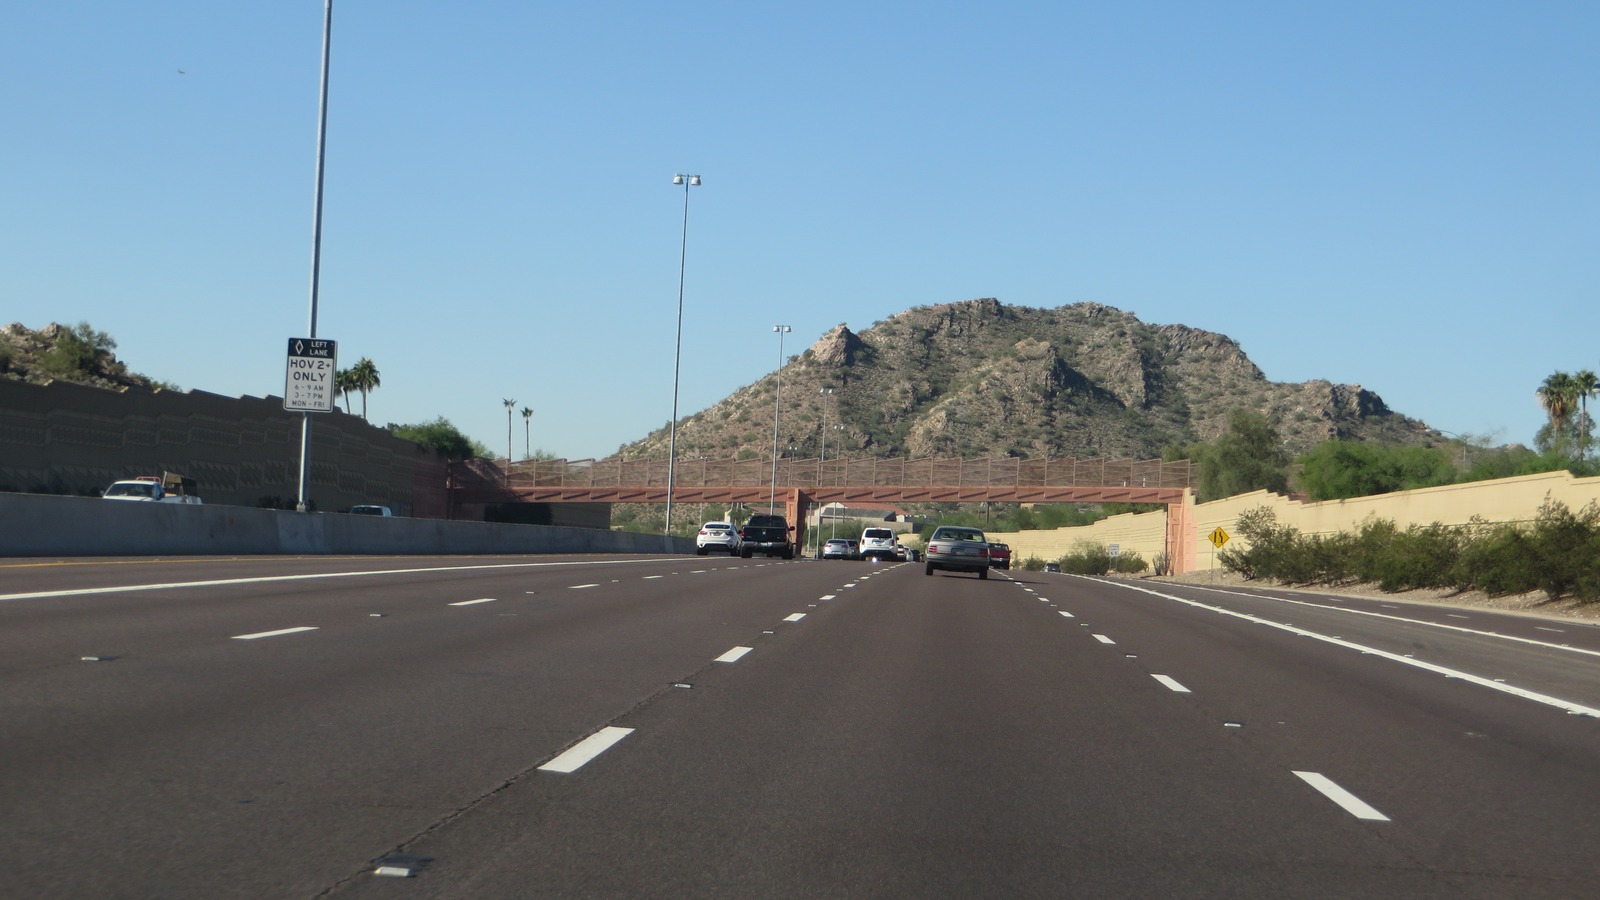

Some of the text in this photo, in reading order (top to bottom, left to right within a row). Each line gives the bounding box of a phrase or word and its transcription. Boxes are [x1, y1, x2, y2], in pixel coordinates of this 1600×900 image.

[290, 359, 331, 369] HOV 2+
[293, 371, 326, 382] ONLY
